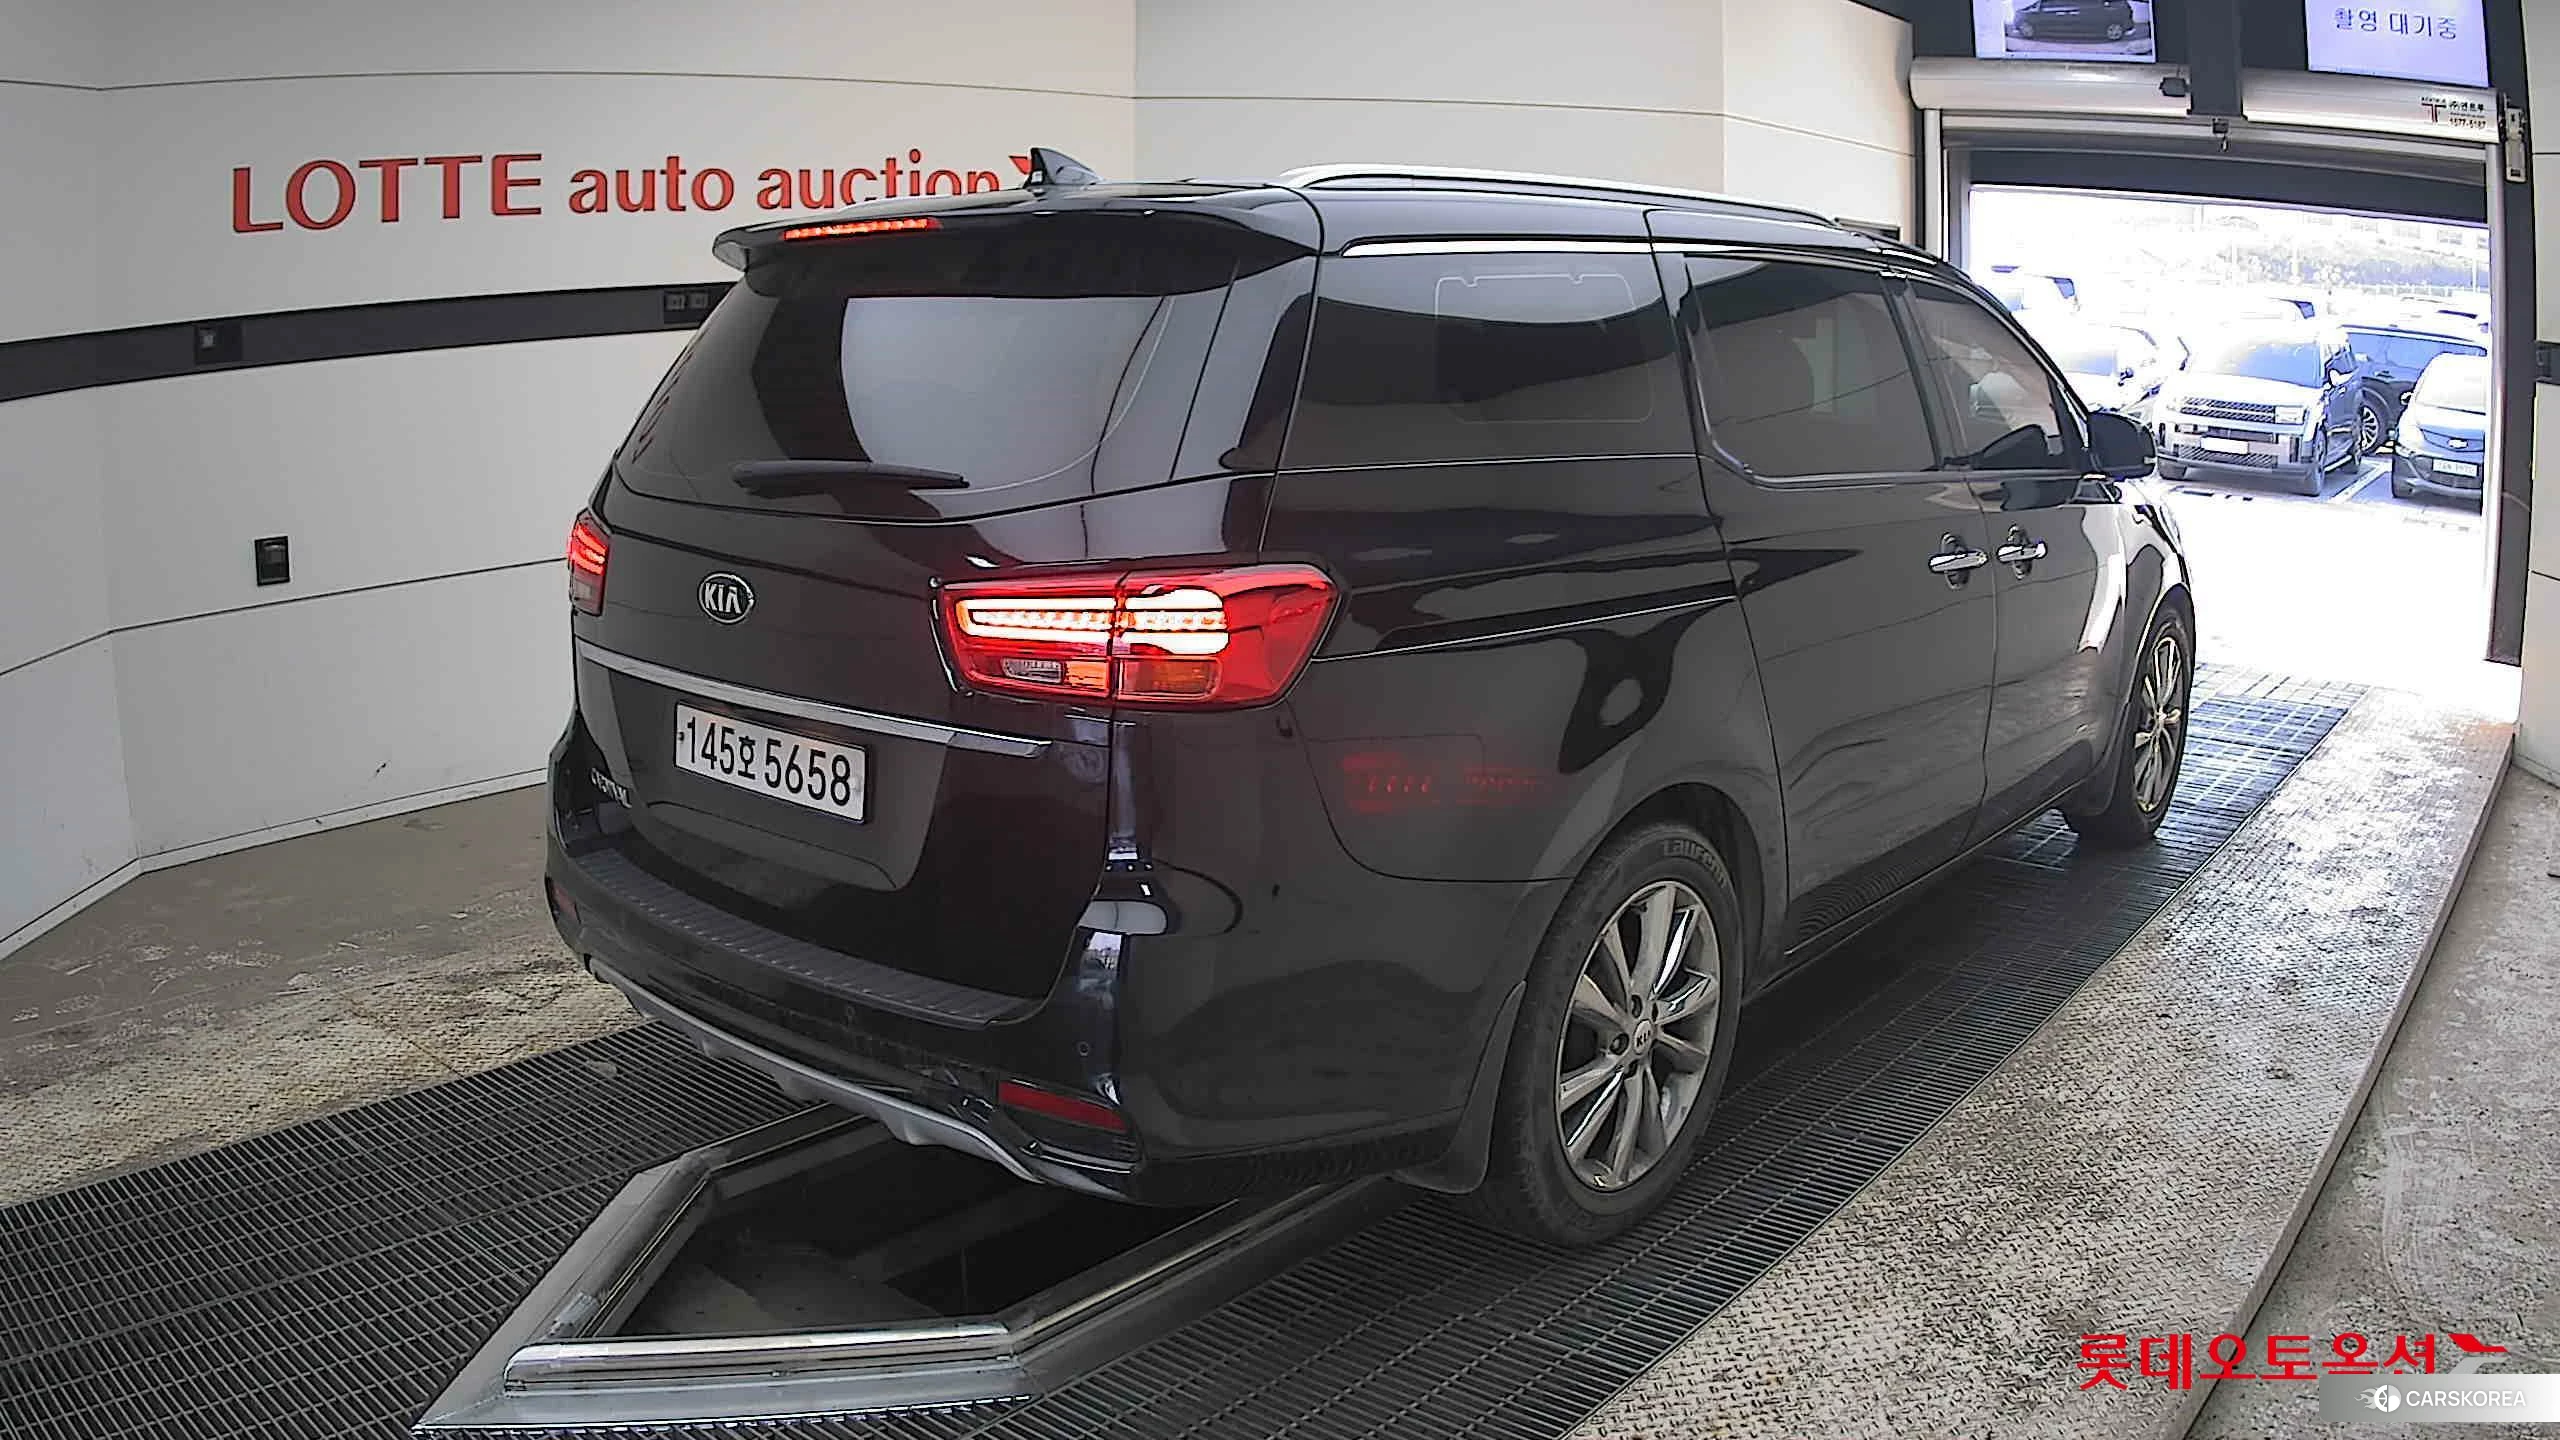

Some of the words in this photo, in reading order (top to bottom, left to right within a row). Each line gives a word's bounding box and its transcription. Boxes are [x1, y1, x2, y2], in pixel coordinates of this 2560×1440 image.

[2389, 12, 2457, 40] 대기중
[232, 152, 543, 233] LOTTE
[568, 155, 735, 214] auto
[756, 148, 1002, 210] auction
[704, 581, 742, 614] KIA
